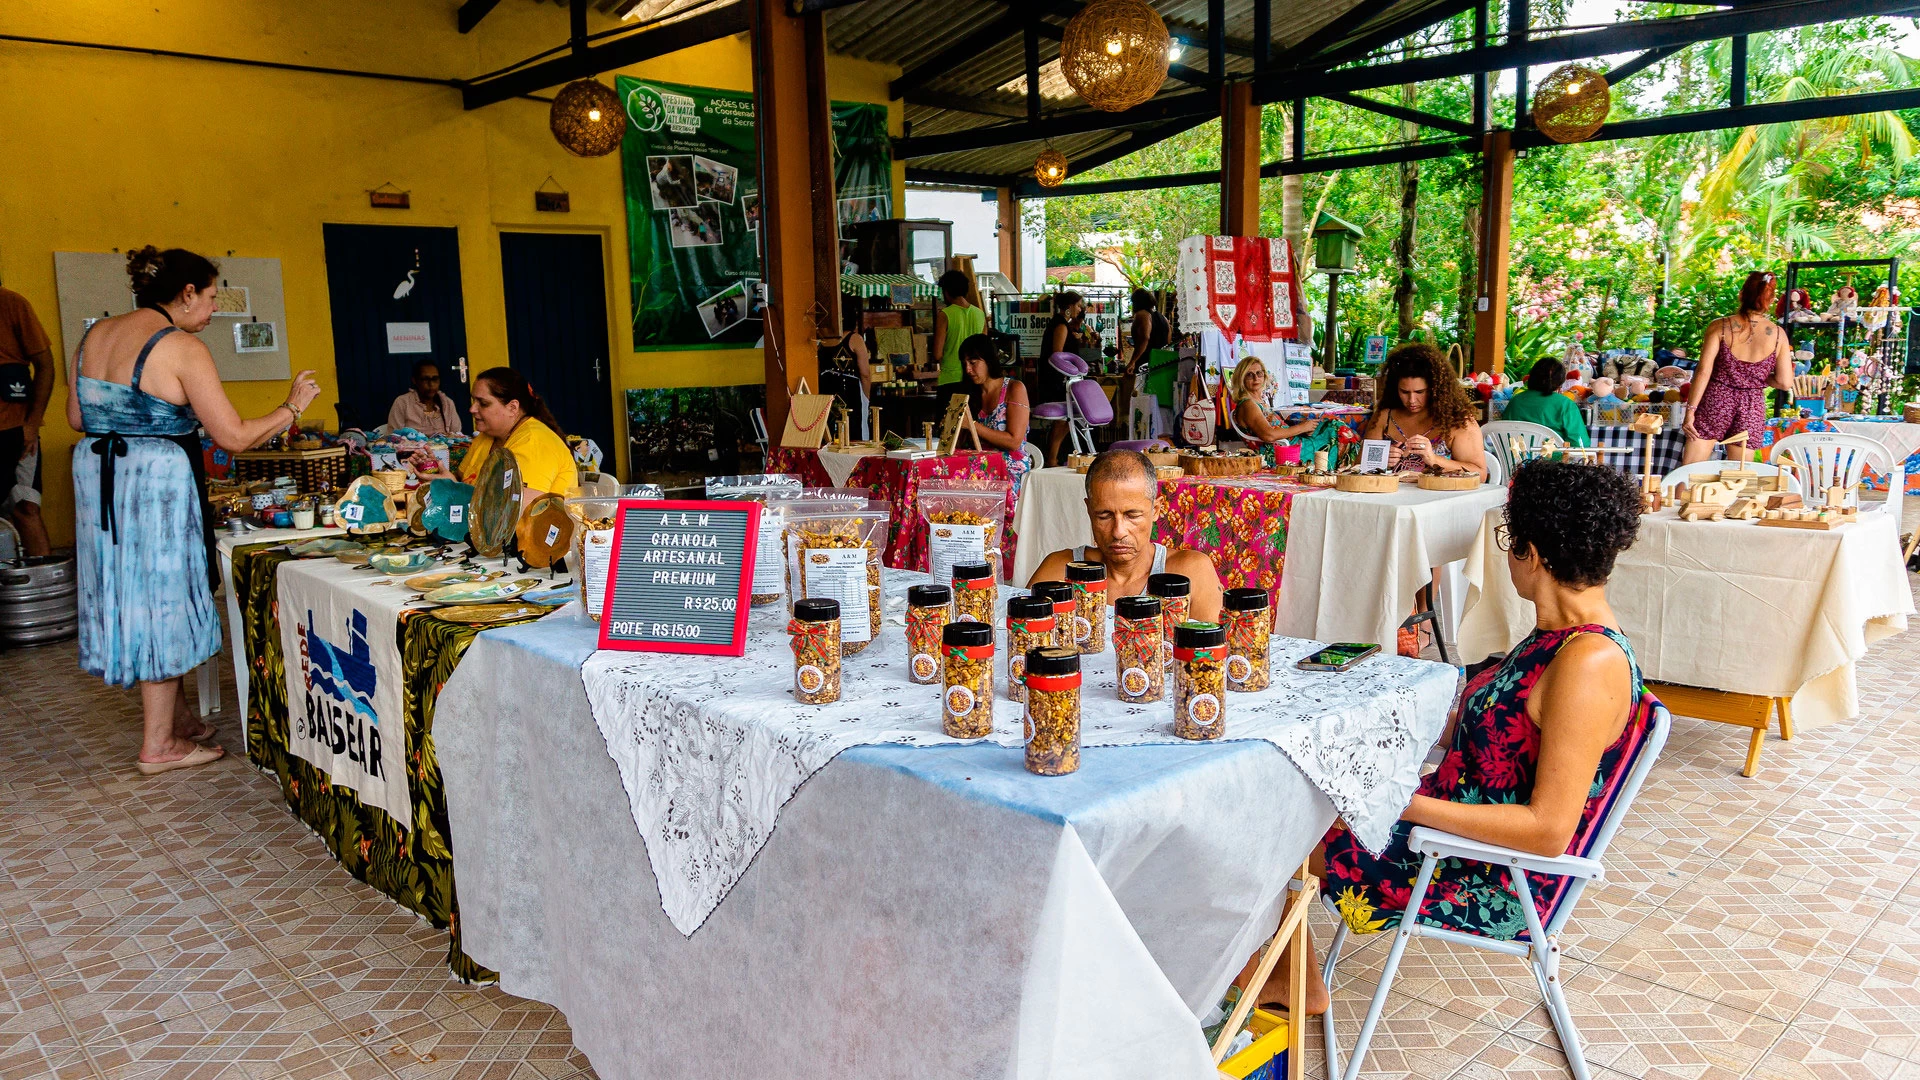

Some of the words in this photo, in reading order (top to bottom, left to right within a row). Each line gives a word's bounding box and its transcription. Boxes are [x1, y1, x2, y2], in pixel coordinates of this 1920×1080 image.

[711, 98, 737, 109] AÇÕES
[739, 102, 750, 110] DE
[703, 105, 713, 113] da
[715, 107, 755, 118] Coordenad
[722, 117, 732, 125] da
[1011, 315, 1027, 329] Lixo
[660, 513, 668, 526] A
[680, 513, 689, 526] &
[698, 514, 709, 526] M
[651, 533, 717, 547] GRANOLA
[643, 550, 725, 565] ARTESANAL
[652, 571, 716, 585] PREMIUM
[612, 621, 644, 635] POTE
[297, 622, 312, 692] REDE
[305, 690, 387, 782] BAISEAR
